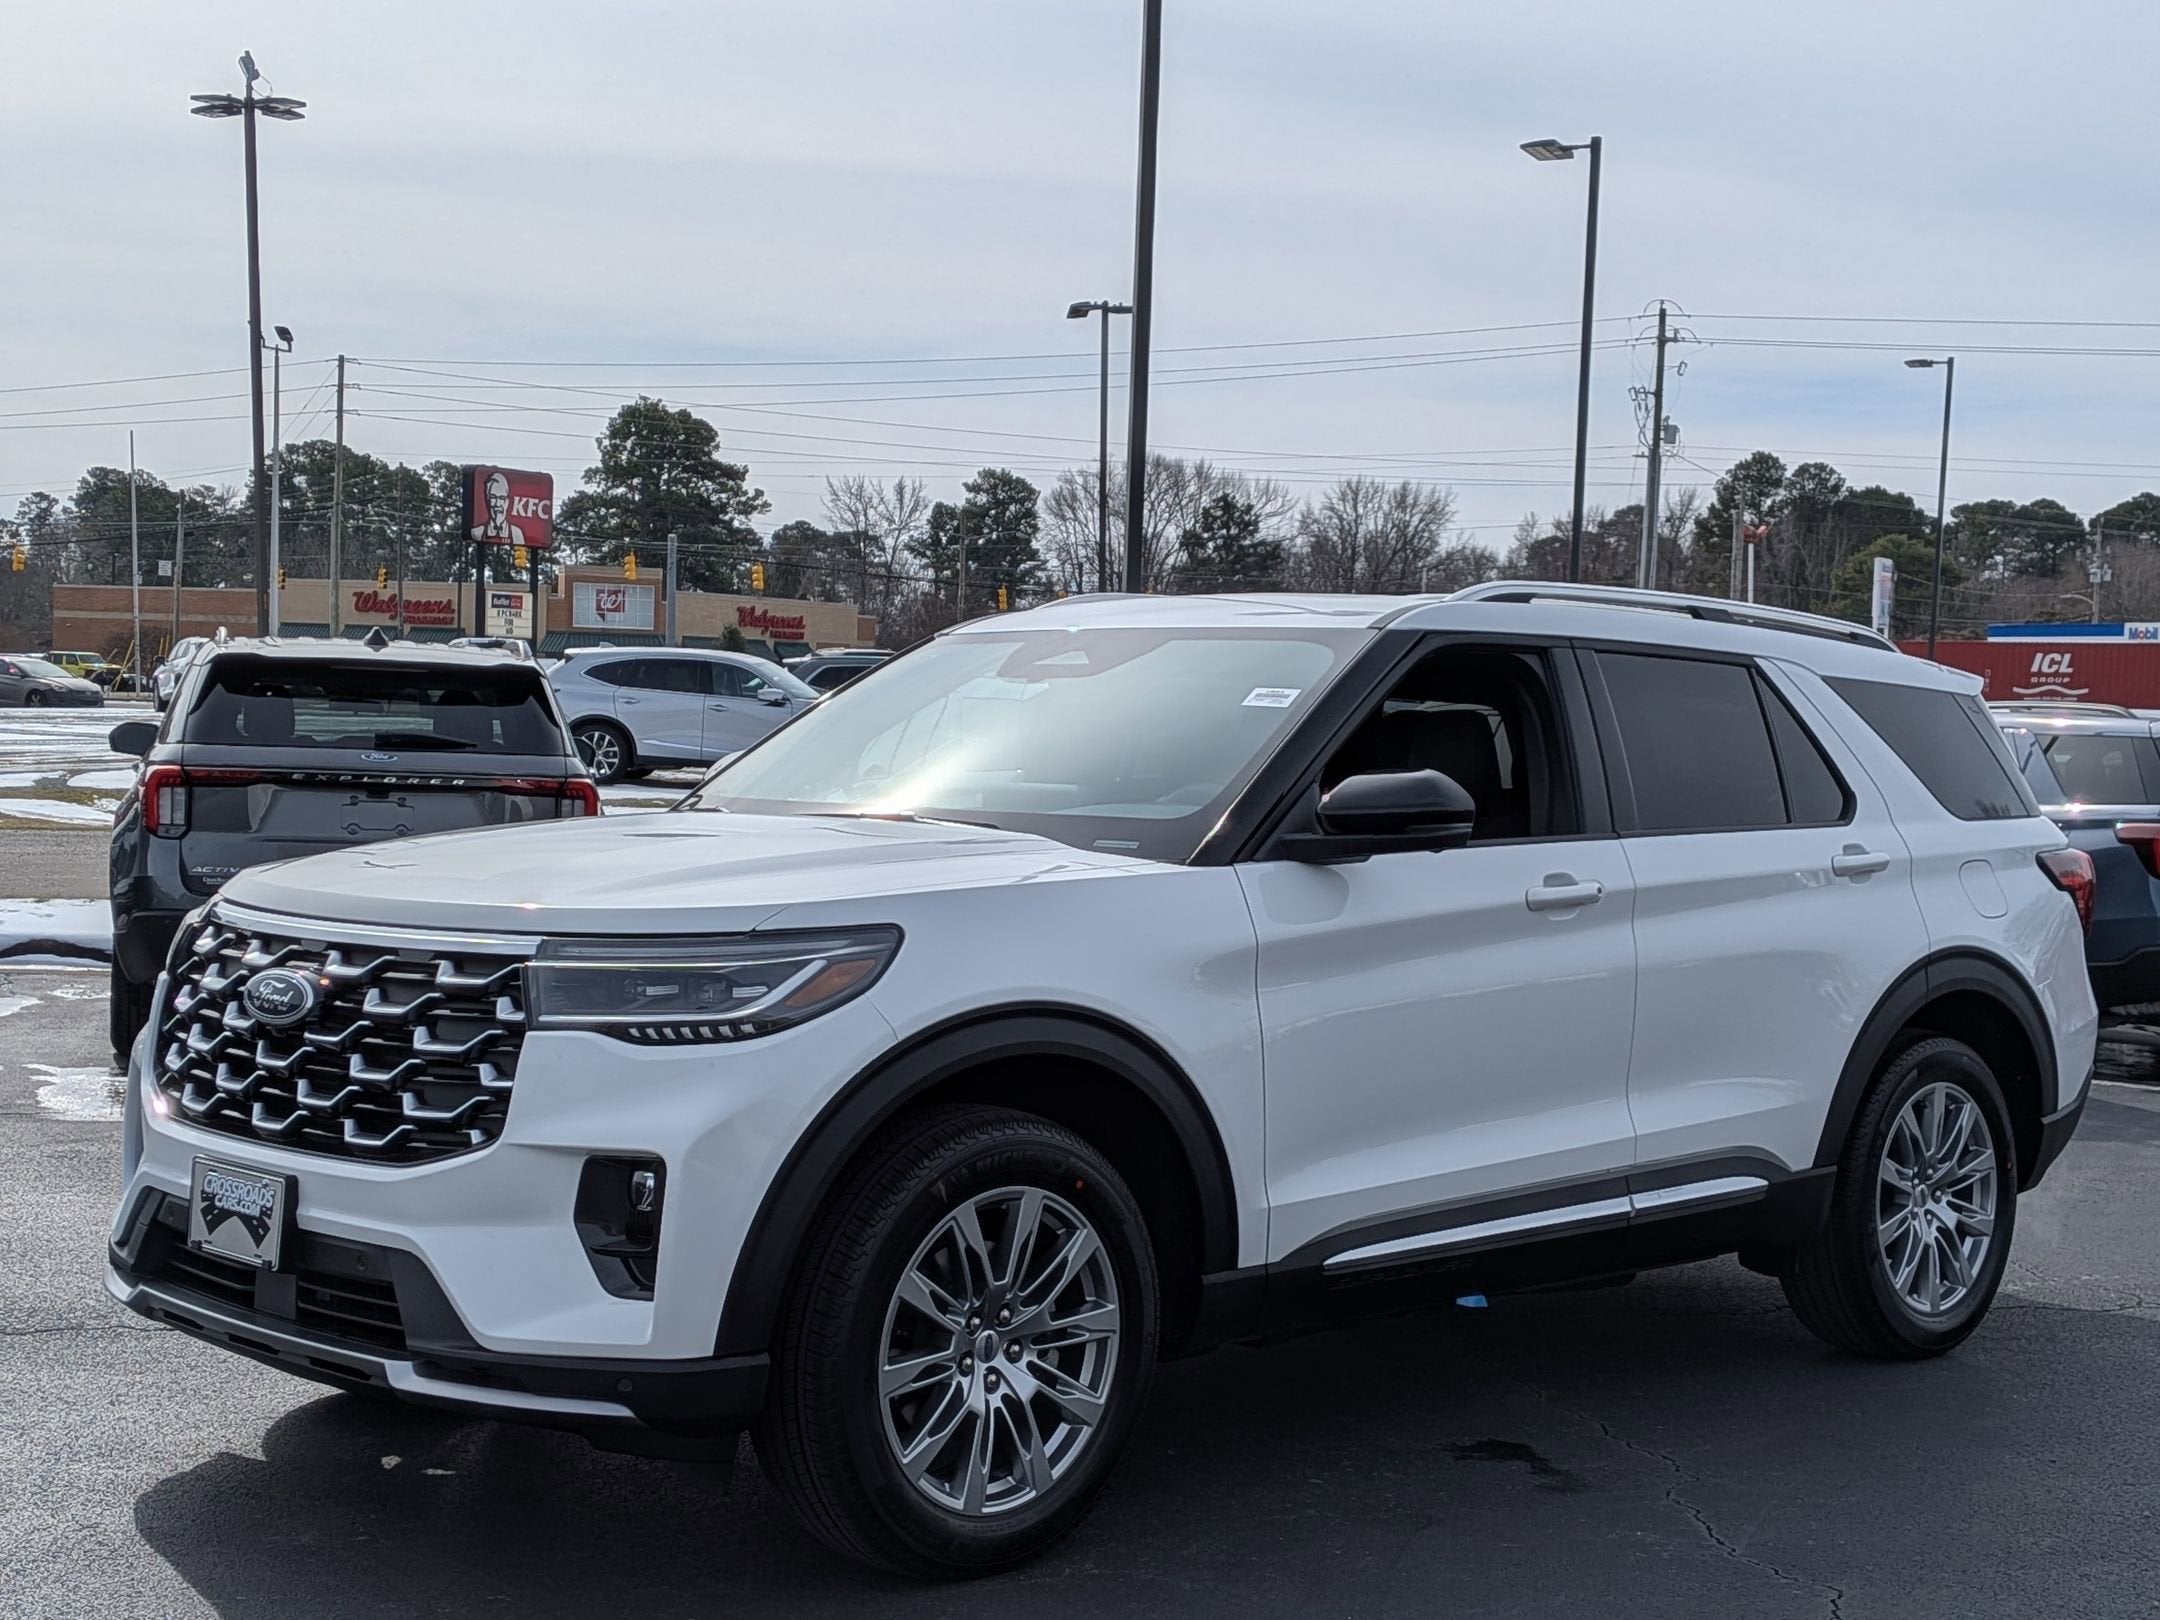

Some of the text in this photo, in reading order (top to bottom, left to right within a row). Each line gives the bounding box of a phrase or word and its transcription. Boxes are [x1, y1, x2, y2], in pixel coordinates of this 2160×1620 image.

[511, 496, 550, 519] KFC
[352, 590, 455, 620] Walgreens
[2128, 627, 2158, 640] Mobil
[2030, 653, 2074, 673] ICL
[292, 773, 465, 785] EXPLORER
[252, 979, 295, 1011] Ford
[203, 1174, 274, 1208] CROSSROADS
